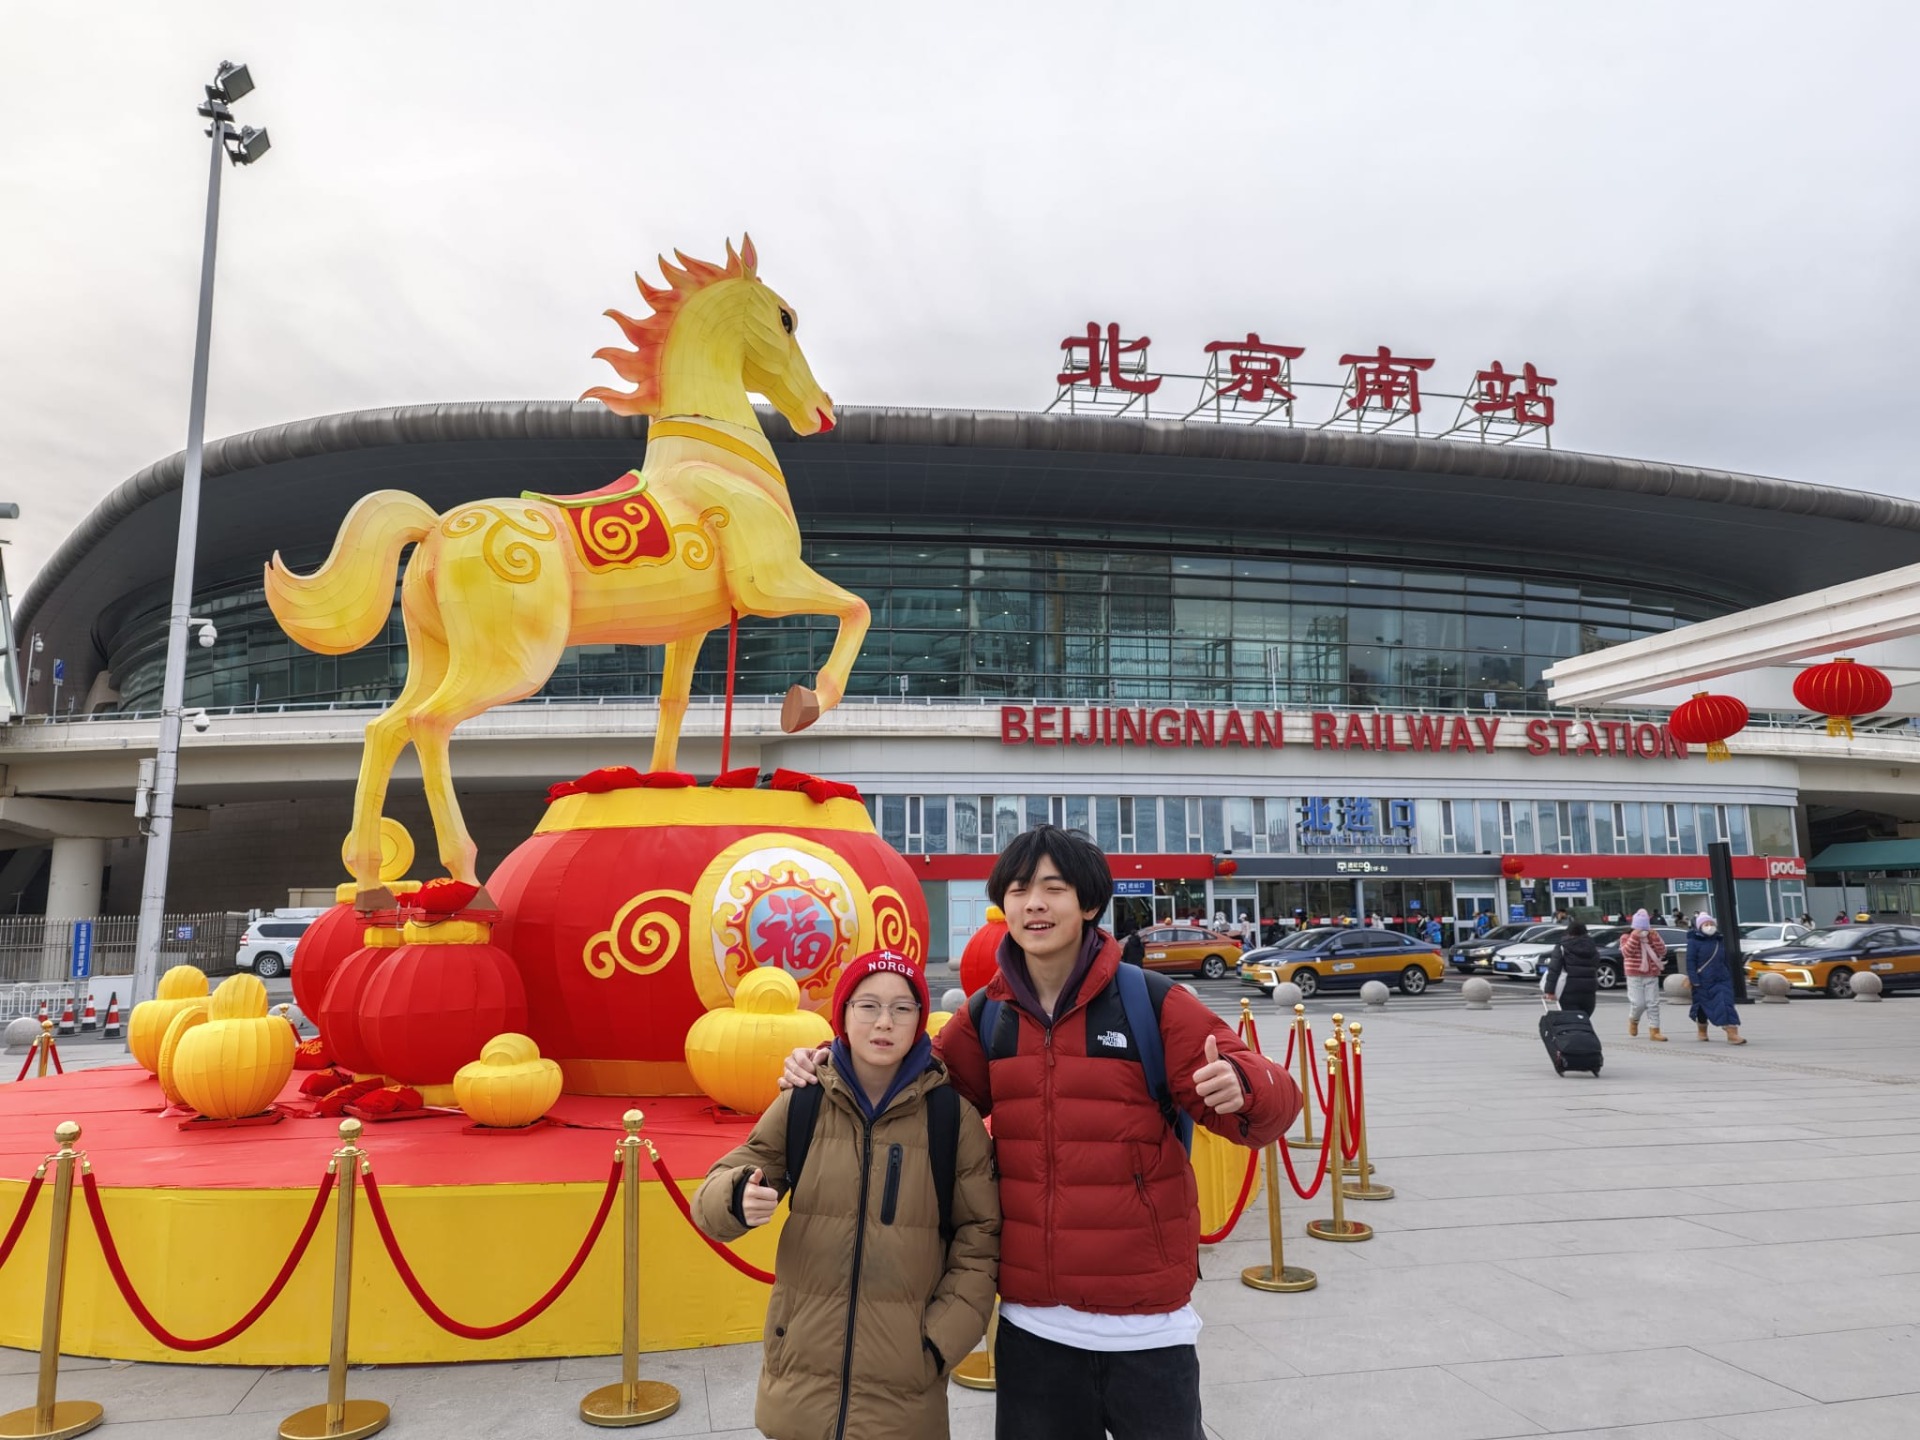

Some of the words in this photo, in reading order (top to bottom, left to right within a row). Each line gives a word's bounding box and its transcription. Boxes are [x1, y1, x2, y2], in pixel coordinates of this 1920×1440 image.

[1056, 321, 1558, 426] 北京南站
[1000, 705, 1284, 750] BEIJINGNAN
[1311, 711, 1501, 755] RAILWAY
[1302, 796, 1416, 832] 北进口
[1350, 834, 1418, 847] Entrance
[753, 893, 832, 970] 福
[868, 961, 915, 977] NORGE
[1097, 1035, 1117, 1043] NORTH
[1102, 1039, 1117, 1047] FACE
